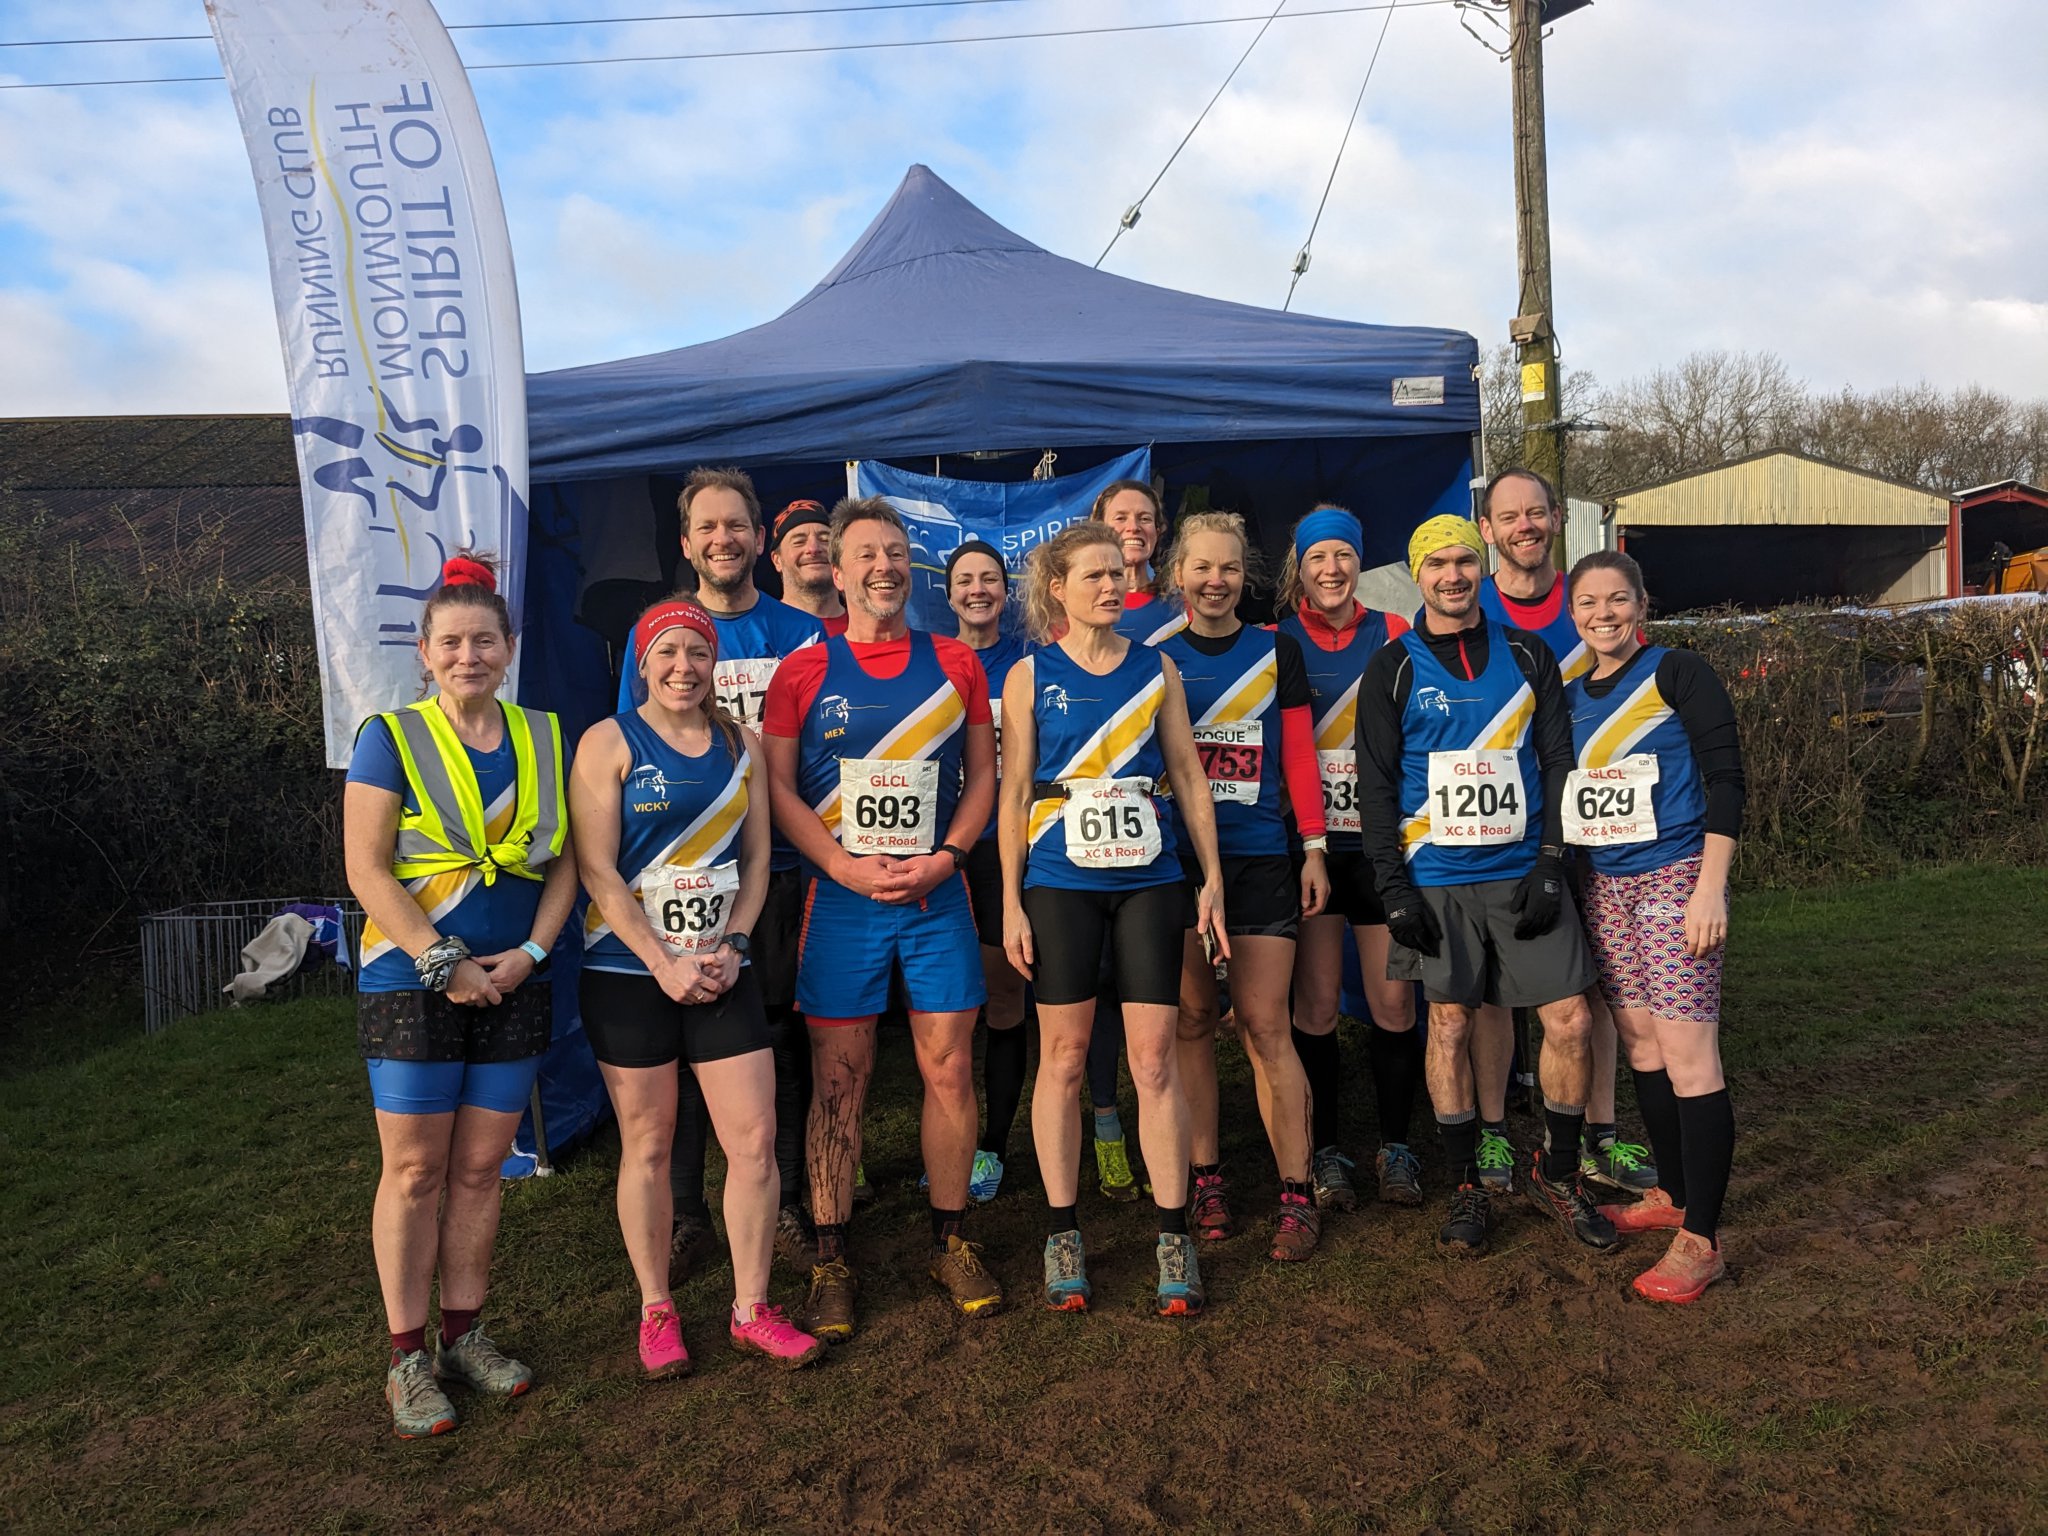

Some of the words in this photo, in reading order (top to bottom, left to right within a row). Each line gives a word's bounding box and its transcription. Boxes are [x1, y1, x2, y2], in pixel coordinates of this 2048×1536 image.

[718, 673, 755, 687] GLCL
[824, 726, 847, 740] MEX
[1197, 746, 1258, 779] 753
[1454, 762, 1496, 776] GLCL
[870, 775, 909, 787] GLCL
[1588, 768, 1627, 780] GLCL
[633, 800, 671, 813] VICKY
[1435, 782, 1519, 818] 1204
[1577, 786, 1635, 821] 629
[856, 794, 921, 829] 693
[1080, 805, 1143, 842] 615
[1332, 817, 1340, 827] &
[1445, 825, 1463, 836] XC
[1467, 826, 1476, 836] &
[1480, 824, 1512, 835] Road
[1582, 826, 1599, 837] XC
[1600, 826, 1608, 836] &
[1610, 823, 1637, 835] Road
[857, 835, 873, 845] XC
[876, 836, 885, 845] &
[888, 836, 917, 846] Road
[1084, 849, 1101, 859] XC
[1104, 847, 1113, 858] &
[1115, 846, 1146, 857] Road
[674, 875, 715, 890] GLCL
[662, 894, 724, 933] 633
[664, 933, 682, 945] XC
[684, 938, 694, 948] &
[697, 933, 719, 949] Road
